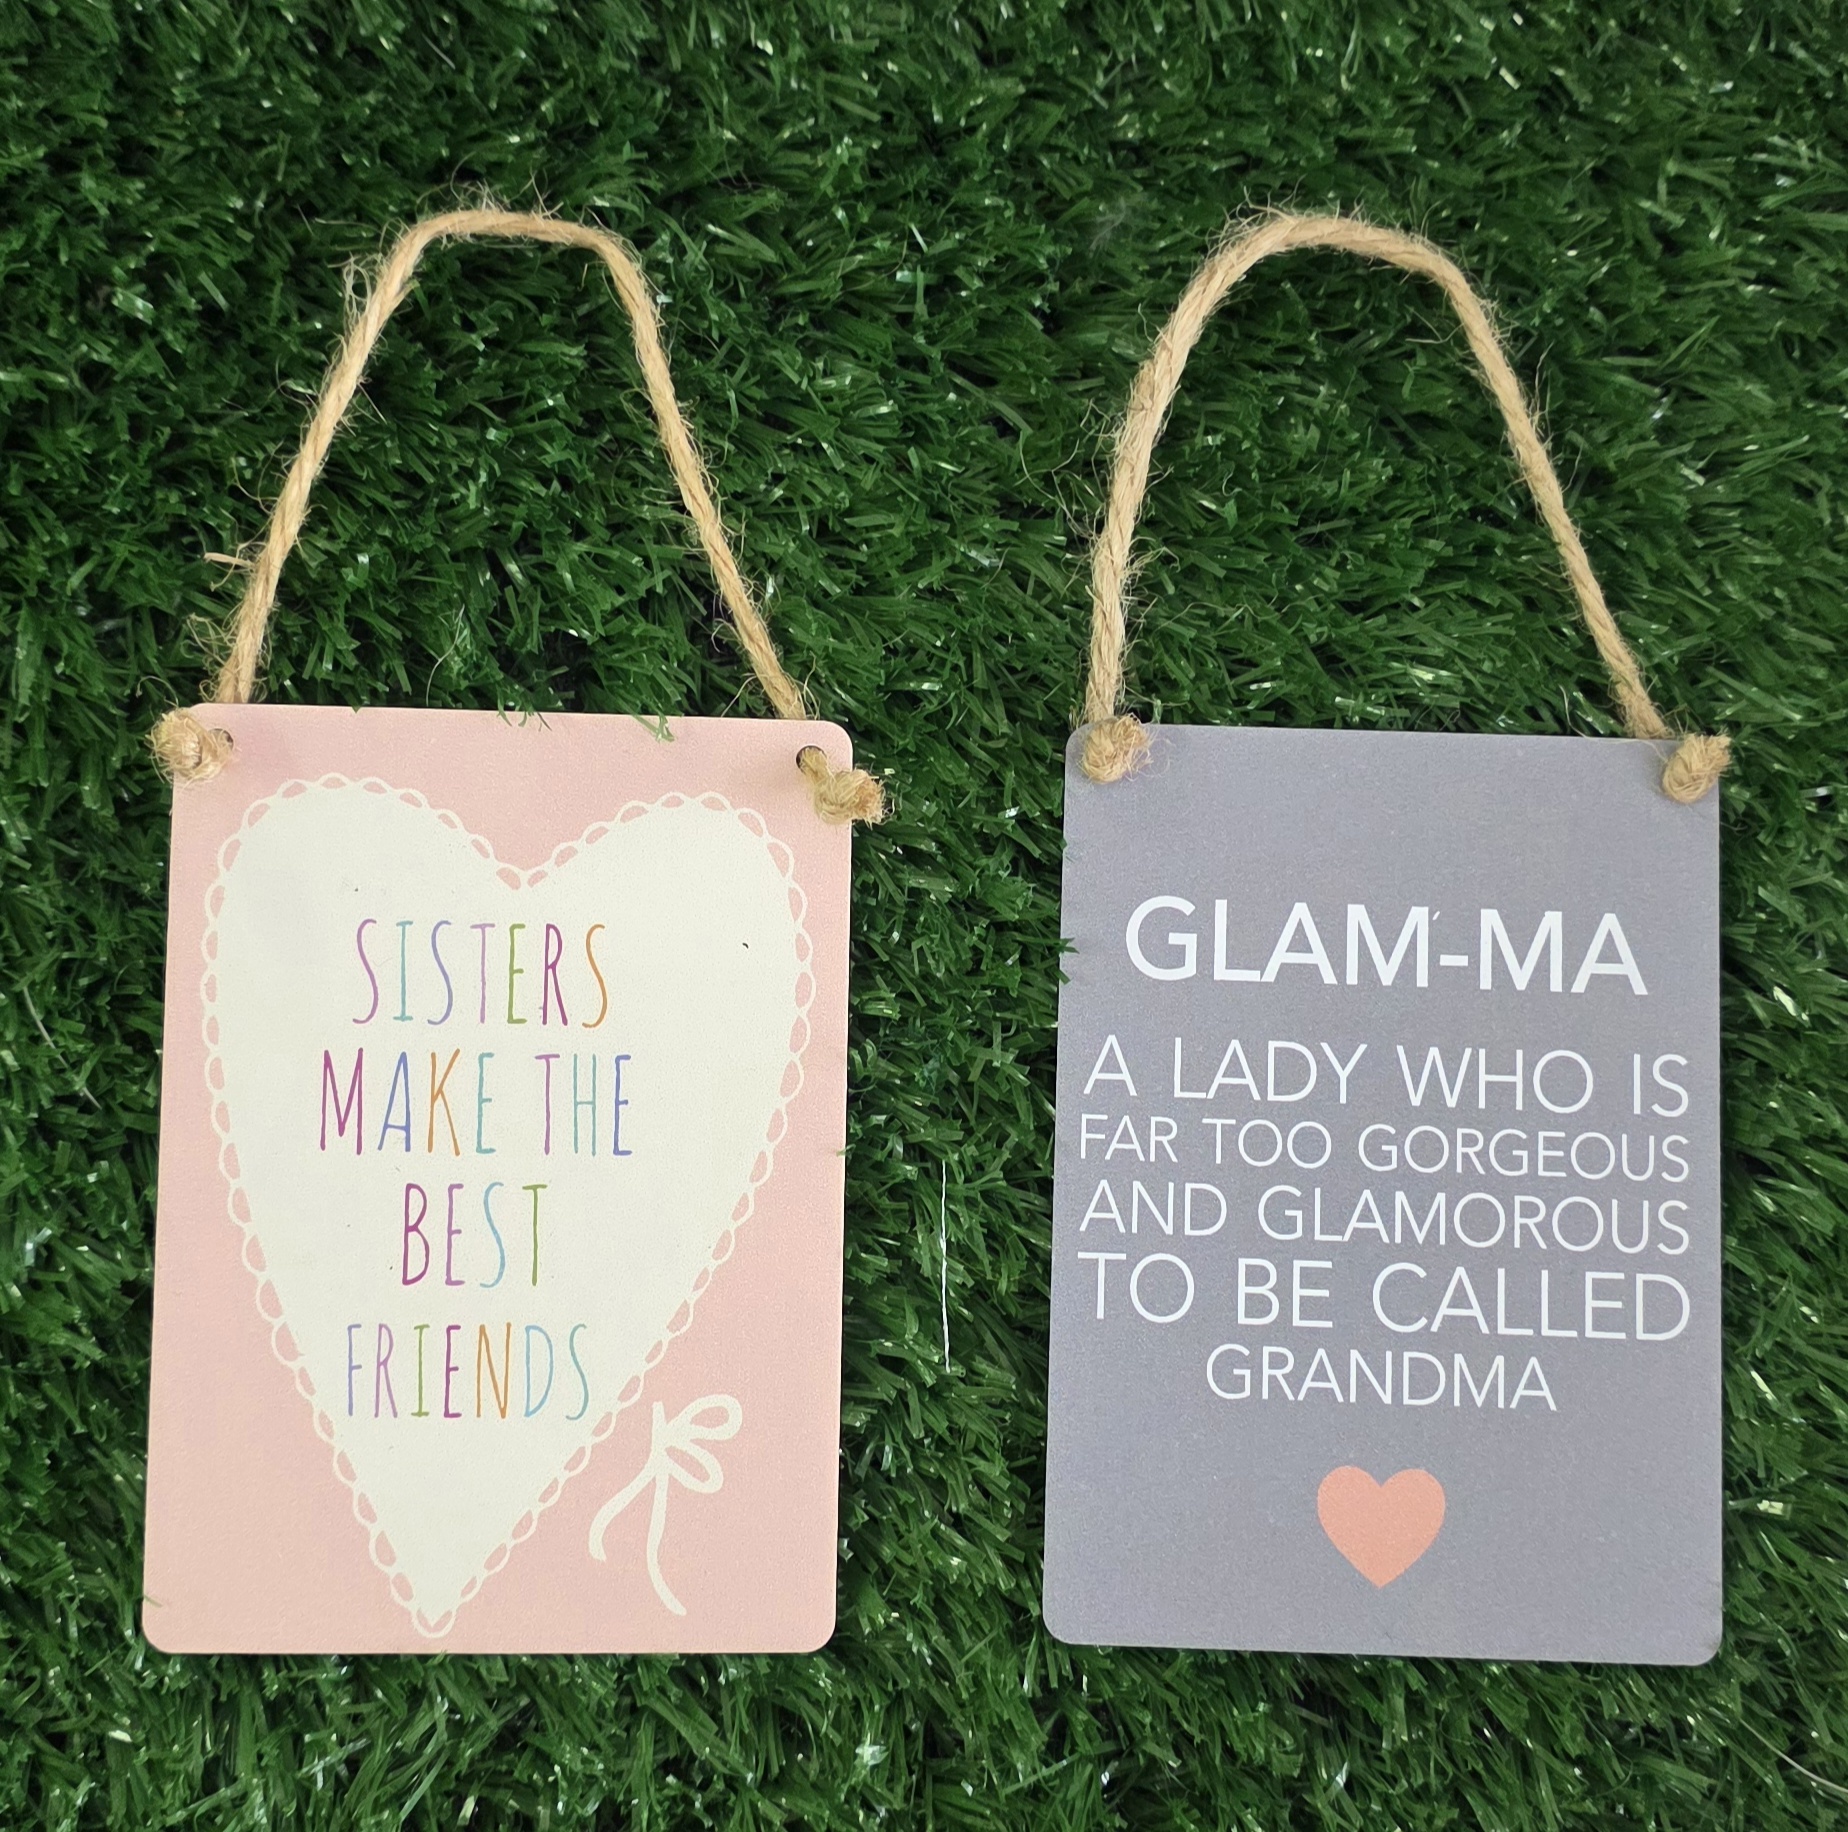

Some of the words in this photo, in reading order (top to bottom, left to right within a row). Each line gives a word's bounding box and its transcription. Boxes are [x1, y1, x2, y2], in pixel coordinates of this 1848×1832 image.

[353, 919, 607, 1028] SISTERS
[1126, 895, 1648, 995] GLAM-MA
[320, 1048, 496, 1156] MAKE
[535, 1054, 632, 1156] THE
[1084, 1035, 1137, 1096] A
[1174, 1037, 1367, 1104] LADY
[1397, 1045, 1593, 1113] WHO
[1634, 1054, 1688, 1117] IS
[1081, 1113, 1178, 1162] FAR
[1202, 1118, 1331, 1169] TOO
[1358, 1124, 1689, 1182] GORGEOUS
[402, 1182, 547, 1288] BEST
[1079, 1180, 1227, 1236] AND
[1258, 1185, 1689, 1254] GLAMOROUS
[1078, 1252, 1194, 1323] TO
[1238, 1258, 1333, 1328] BE
[1373, 1263, 1690, 1340] CALLED
[348, 1322, 588, 1420] FRIENDS
[1207, 1344, 1556, 1411] GRANDMA
